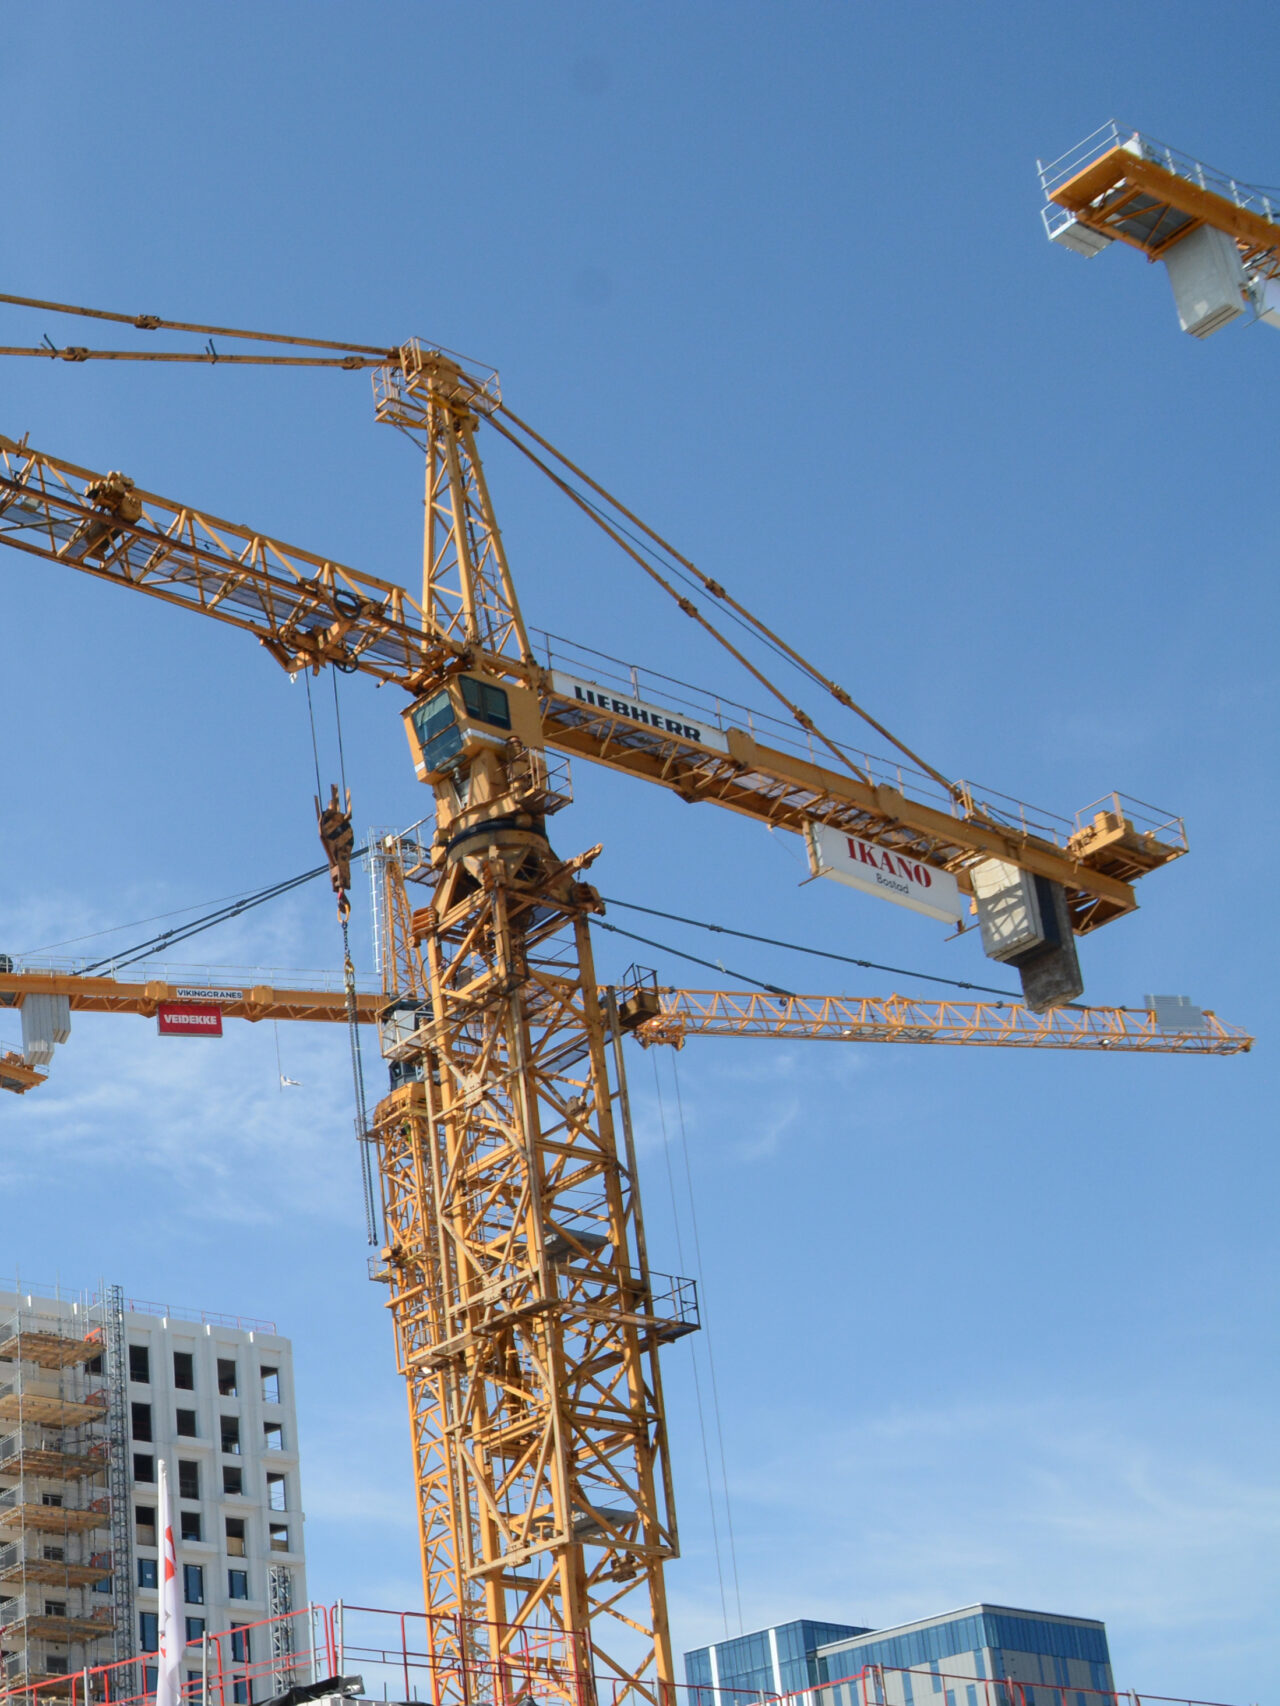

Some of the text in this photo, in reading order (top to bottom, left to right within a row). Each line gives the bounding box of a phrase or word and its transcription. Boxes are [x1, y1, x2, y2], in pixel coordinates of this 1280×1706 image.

[574, 685, 702, 743] LIEBHERR
[846, 837, 932, 888] IKANO
[876, 873, 910, 894] Bostad
[177, 989, 242, 999] VIKINGCRANES
[164, 1014, 217, 1025] VEIDEKKE
